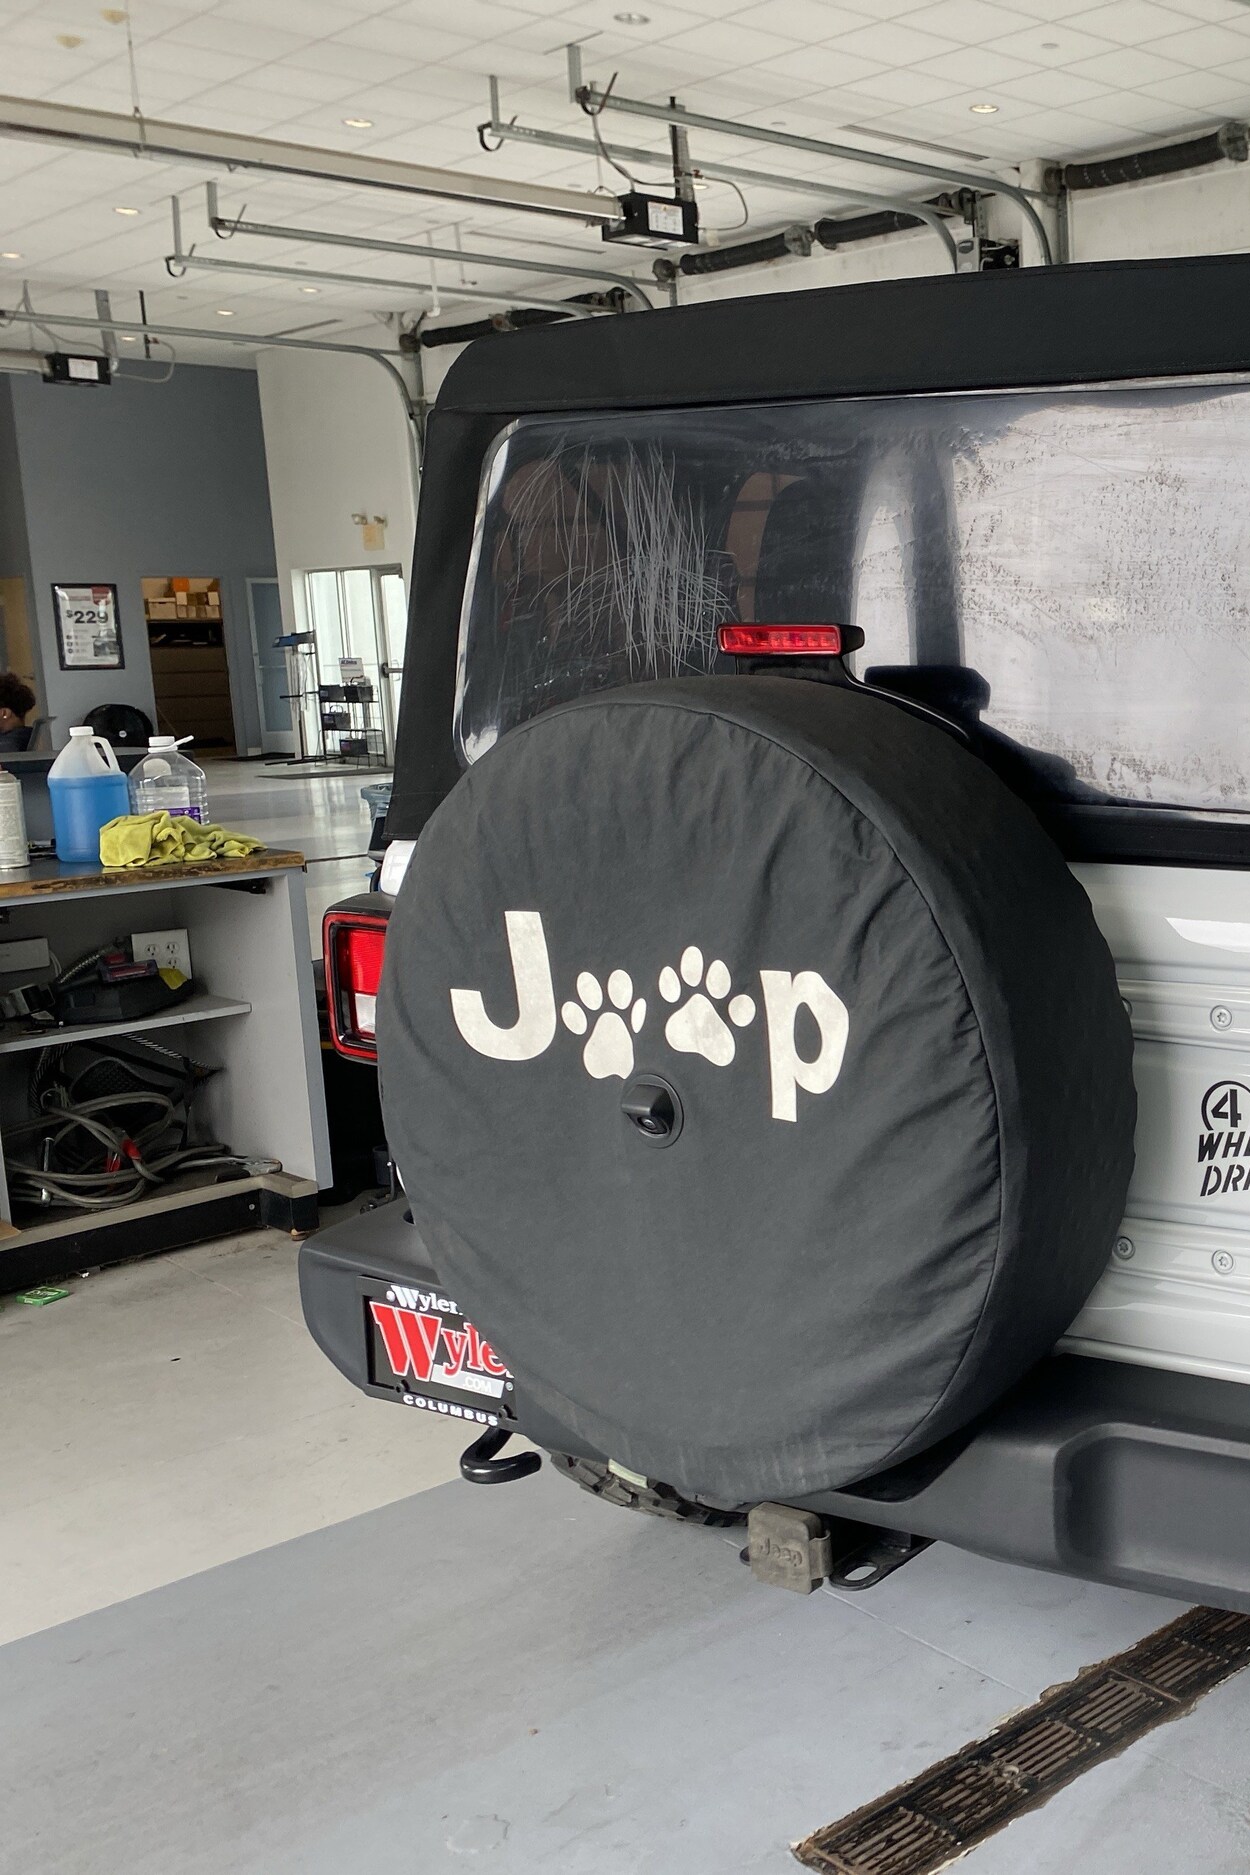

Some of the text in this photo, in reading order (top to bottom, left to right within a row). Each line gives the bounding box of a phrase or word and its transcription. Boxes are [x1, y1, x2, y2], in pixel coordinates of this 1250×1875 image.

[1211, 1089, 1242, 1128] 4
[369, 1301, 515, 1383] Wyle
[403, 1394, 498, 1426] COLUMBUS
